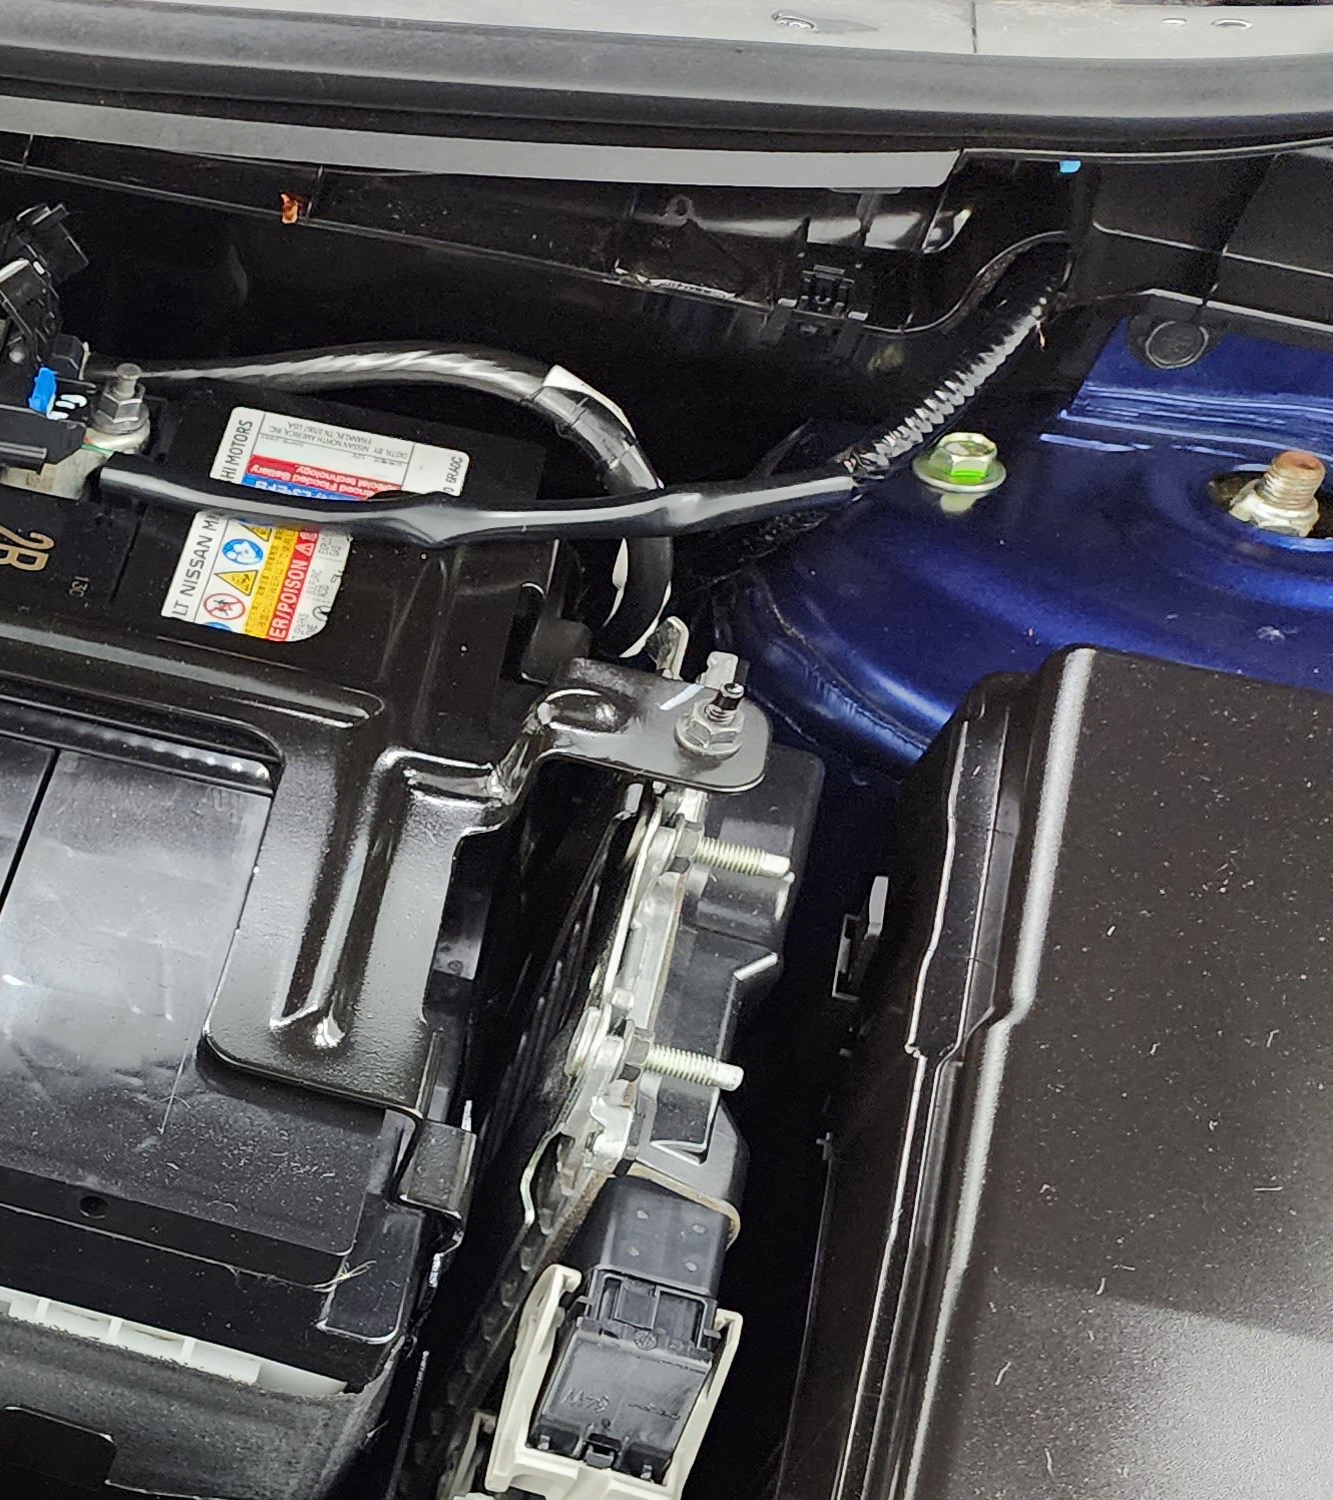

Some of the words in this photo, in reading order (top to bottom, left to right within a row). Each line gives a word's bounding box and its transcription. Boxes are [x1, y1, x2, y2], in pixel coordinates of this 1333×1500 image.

[249, 463, 291, 481] Battery
[291, 473, 338, 491] Flooded
[179, 534, 213, 598] NISSAN
[229, 418, 253, 466] MOTORS
